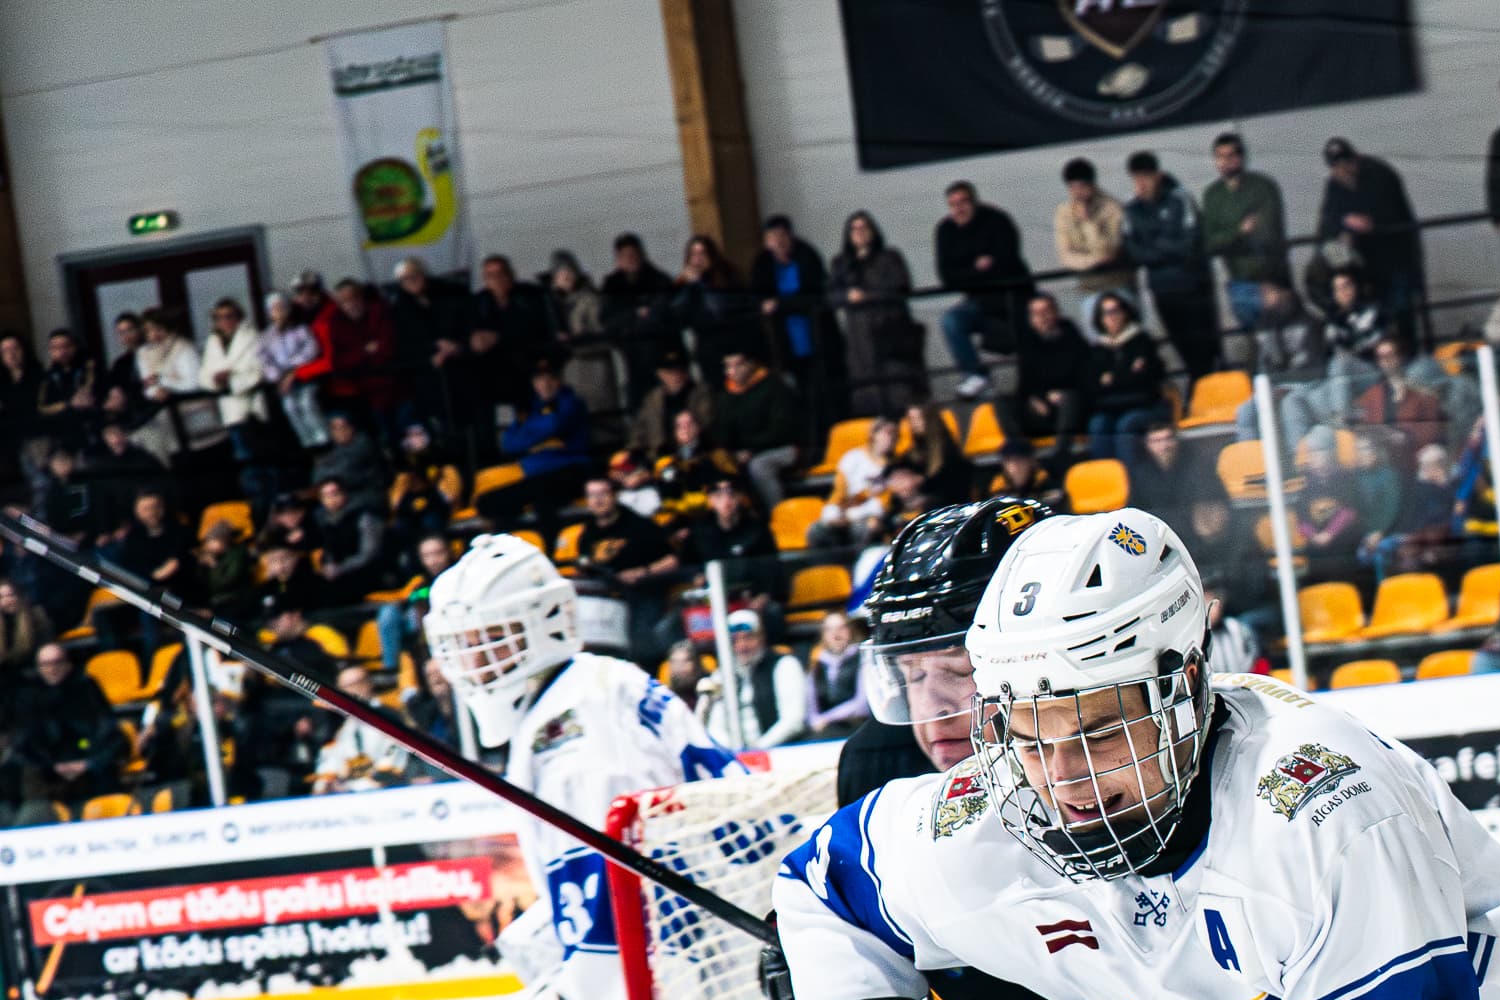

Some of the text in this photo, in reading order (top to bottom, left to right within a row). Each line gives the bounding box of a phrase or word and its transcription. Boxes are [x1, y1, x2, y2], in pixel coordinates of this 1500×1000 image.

[1012, 581, 1042, 616] 3
[1311, 781, 1372, 827] RĪGAS DOME
[149, 900, 183, 926] ar
[1203, 908, 1242, 974] A
[103, 945, 139, 974] ar
